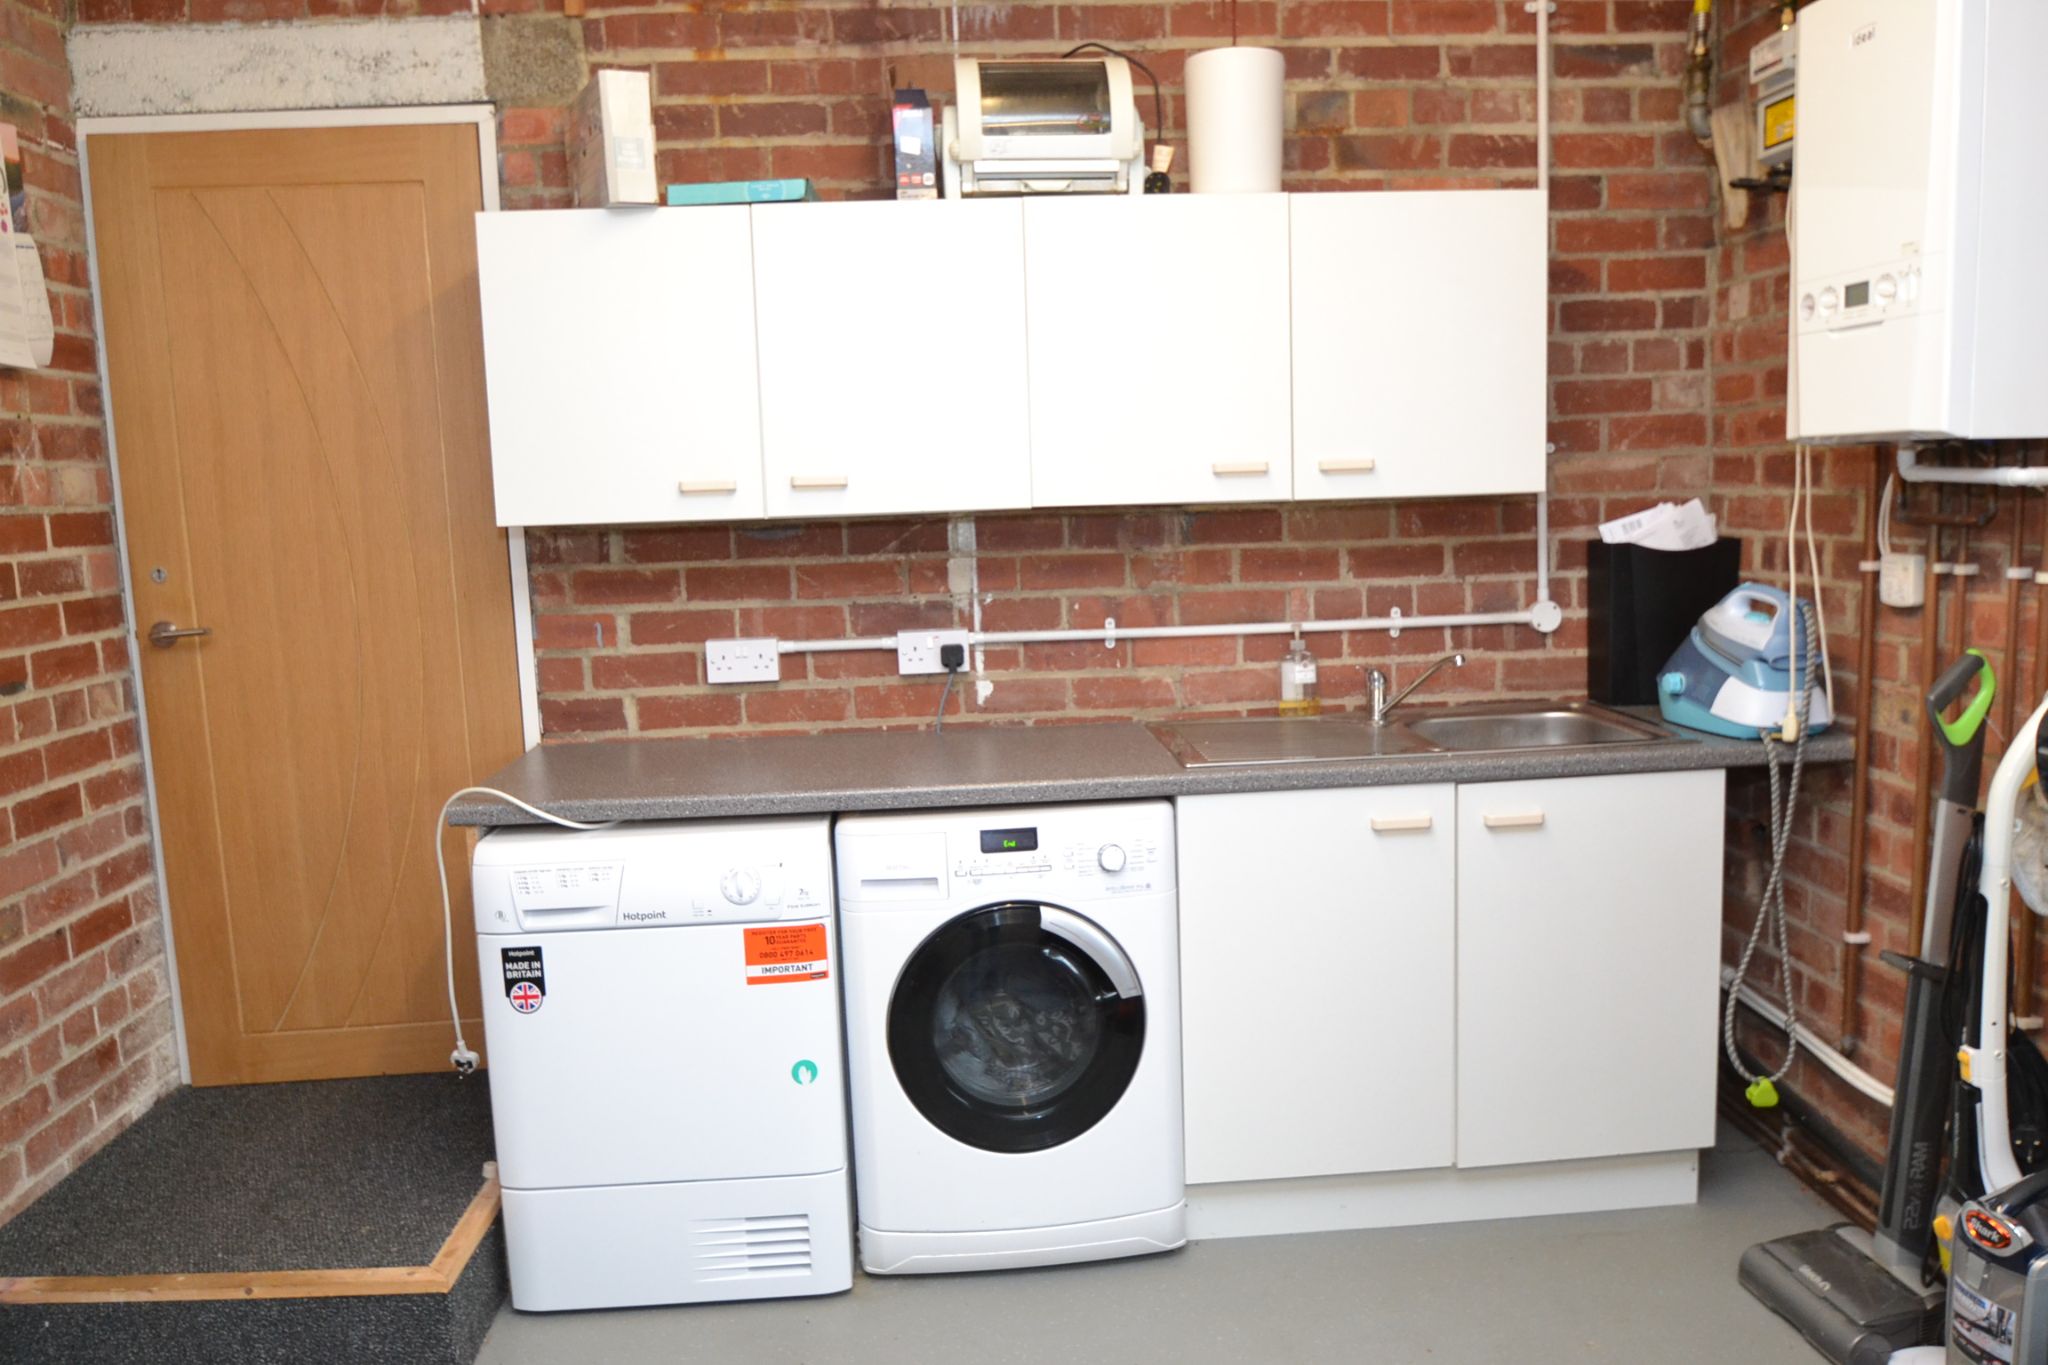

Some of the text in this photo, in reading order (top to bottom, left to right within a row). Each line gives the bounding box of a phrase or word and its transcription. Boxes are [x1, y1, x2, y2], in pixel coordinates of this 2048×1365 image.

[623, 910, 667, 922] Hotpoint
[765, 935, 776, 945] 10
[505, 961, 541, 970] MADE IN
[761, 963, 813, 975] IMPORTANT
[506, 970, 542, 979] BRITAIN
